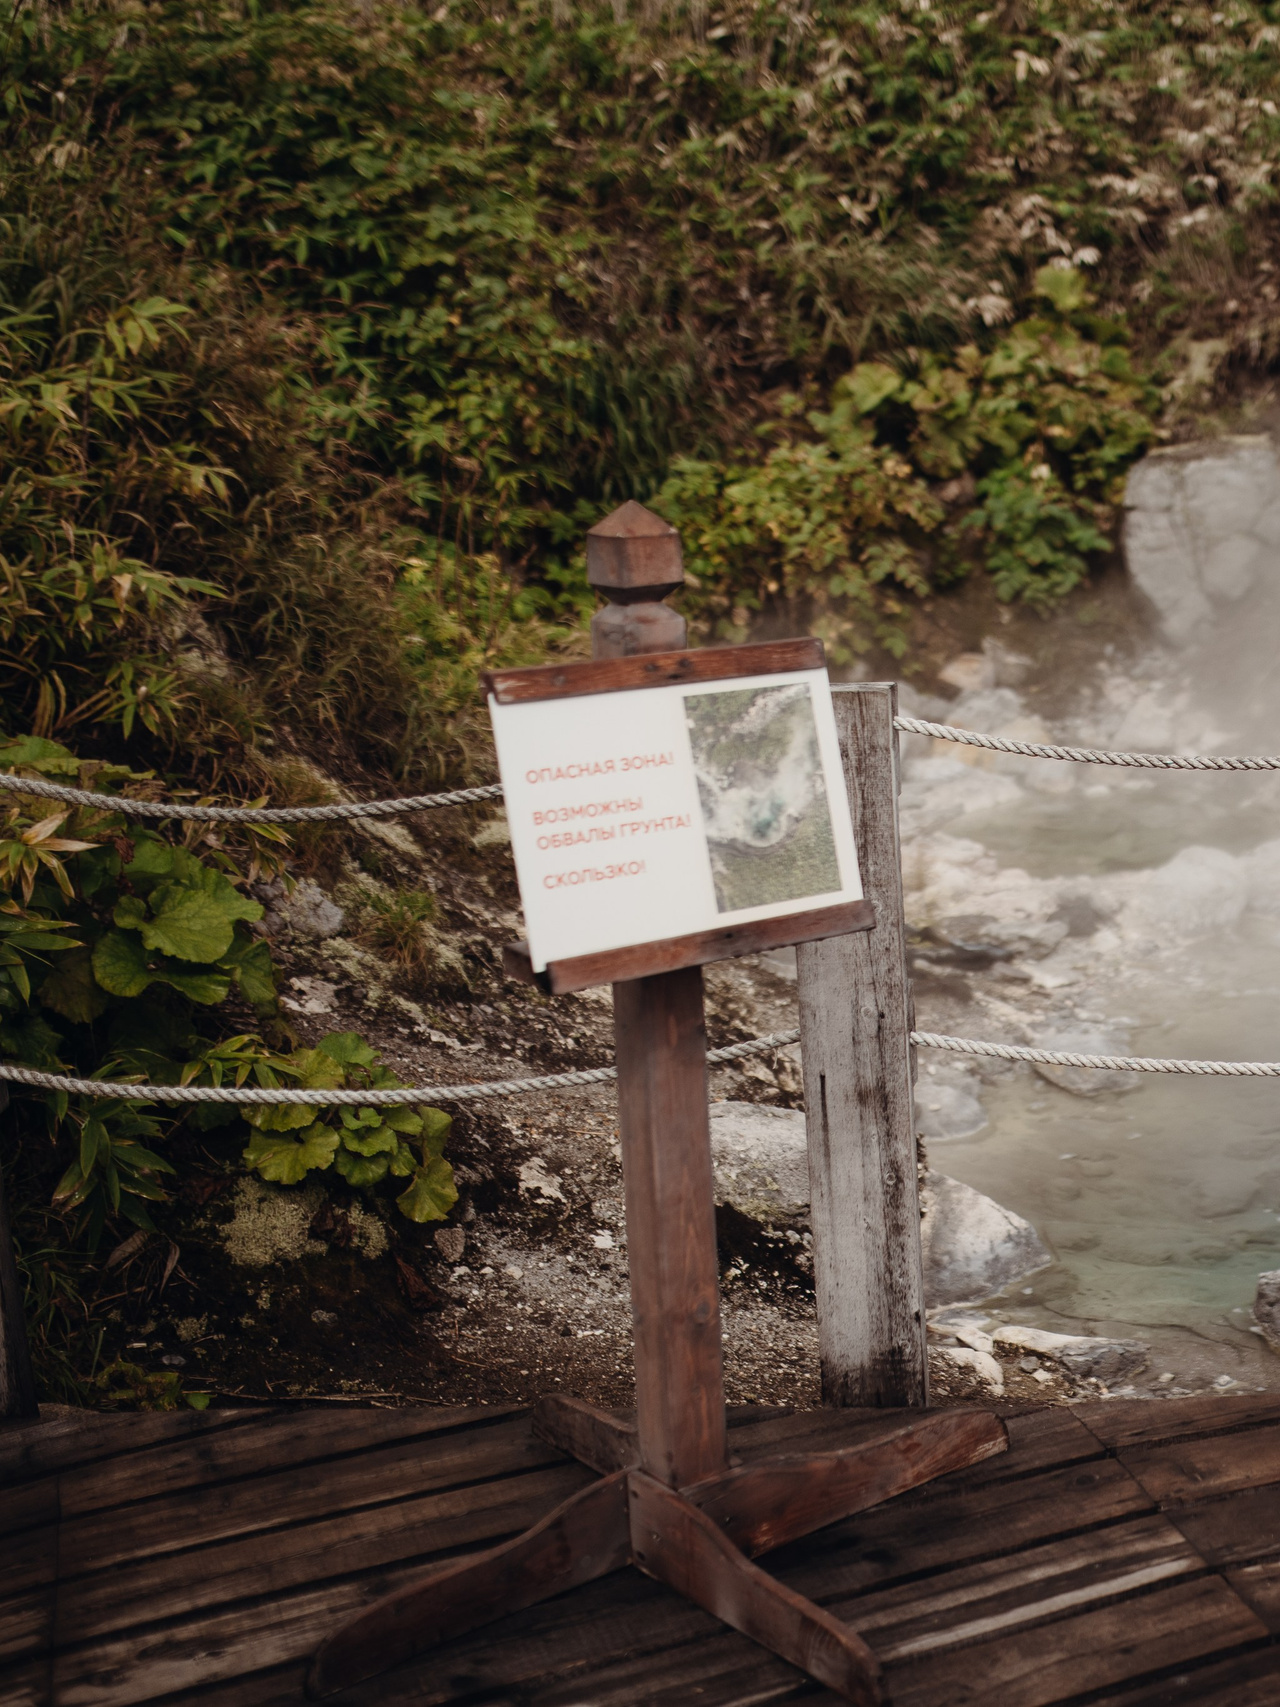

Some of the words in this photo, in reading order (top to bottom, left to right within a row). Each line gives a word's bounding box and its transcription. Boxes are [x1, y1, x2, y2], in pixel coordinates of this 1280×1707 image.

[526, 760, 615, 784] ОПАСНАЯ
[620, 752, 674, 772] ЗОНА!
[532, 797, 643, 826] ВОЗМОЖНЫ
[537, 823, 615, 850] ОБВАЛЫ
[619, 814, 692, 839] ГРУНТА!
[543, 860, 646, 890] СКОЛЬЗКО!
